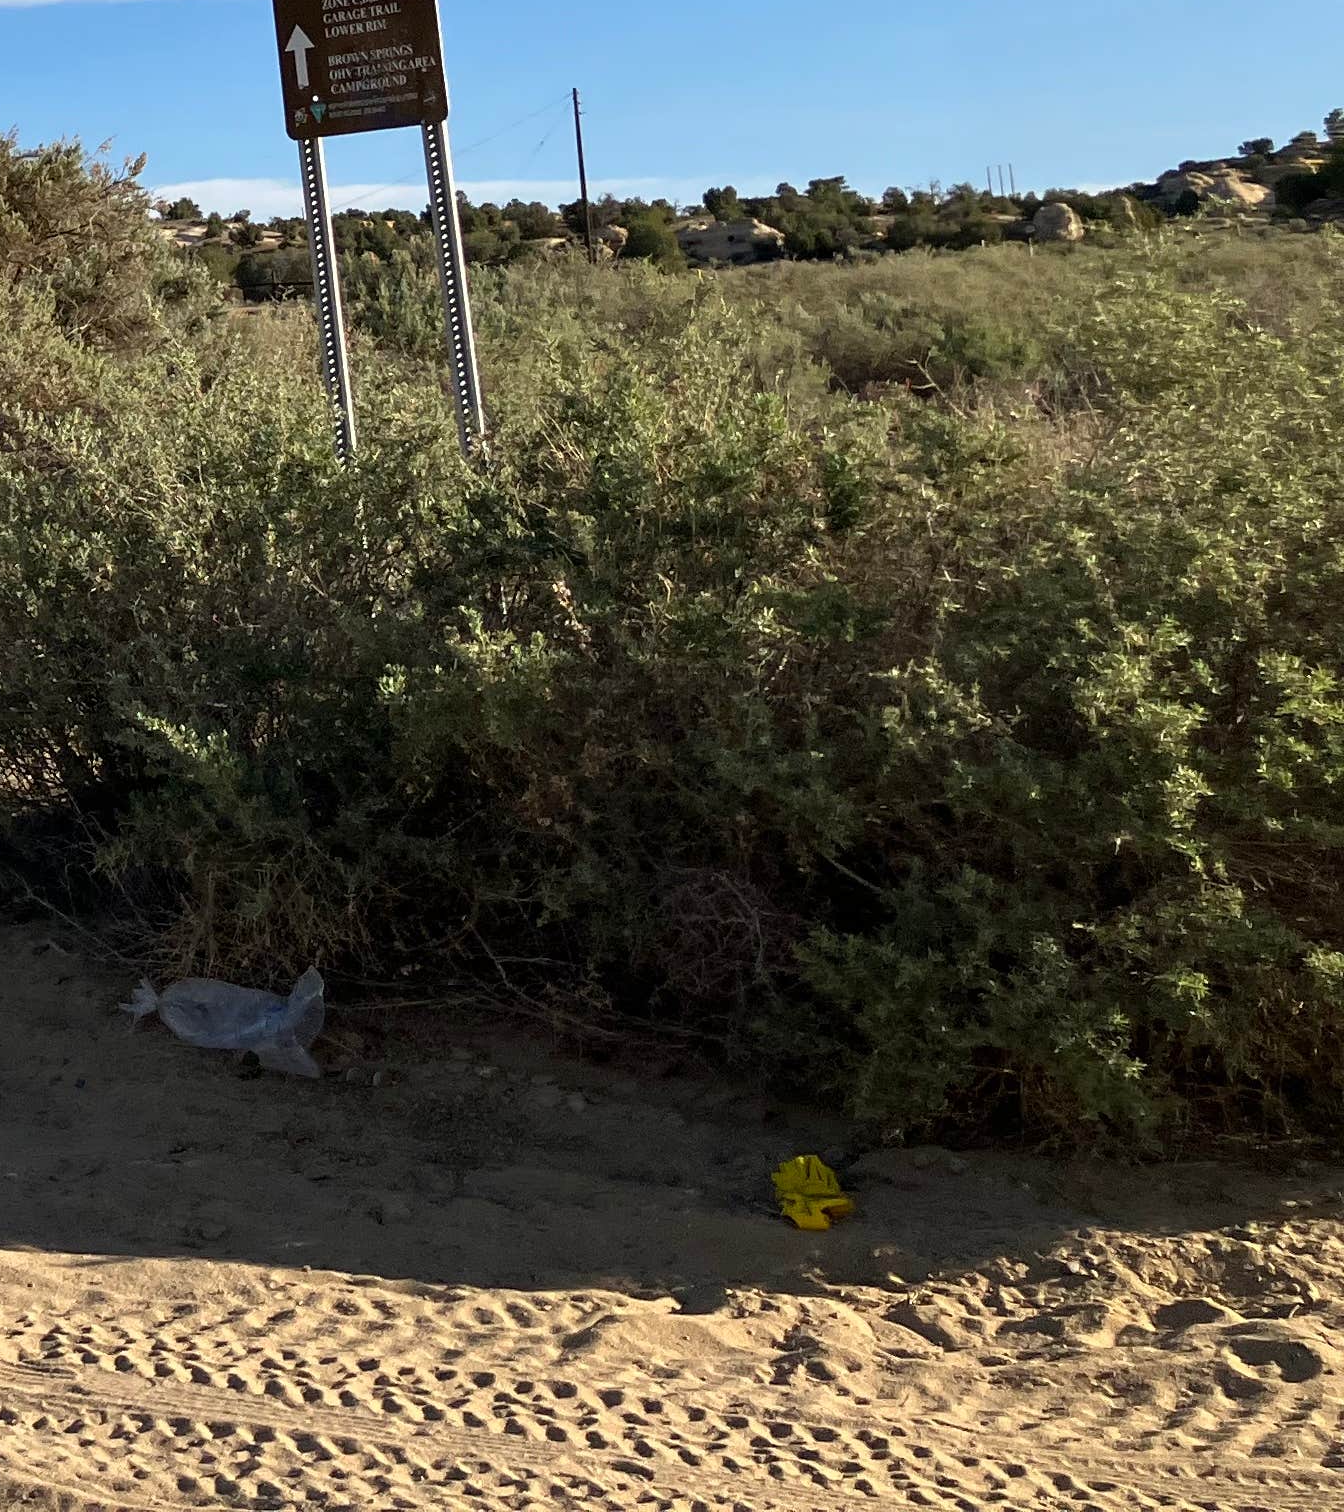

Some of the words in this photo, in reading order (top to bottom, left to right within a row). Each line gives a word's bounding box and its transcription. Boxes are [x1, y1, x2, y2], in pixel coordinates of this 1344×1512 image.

[323, 8, 367, 24] GARAGE
[368, 2, 401, 17] TRAIL
[324, 22, 363, 39] LOWER
[365, 19, 387, 32] RIM
[328, 51, 369, 67] BROWN
[369, 44, 413, 60] SPRINGS
[407, 55, 436, 69] AREA
[330, 74, 407, 95] CAMPGROUND
